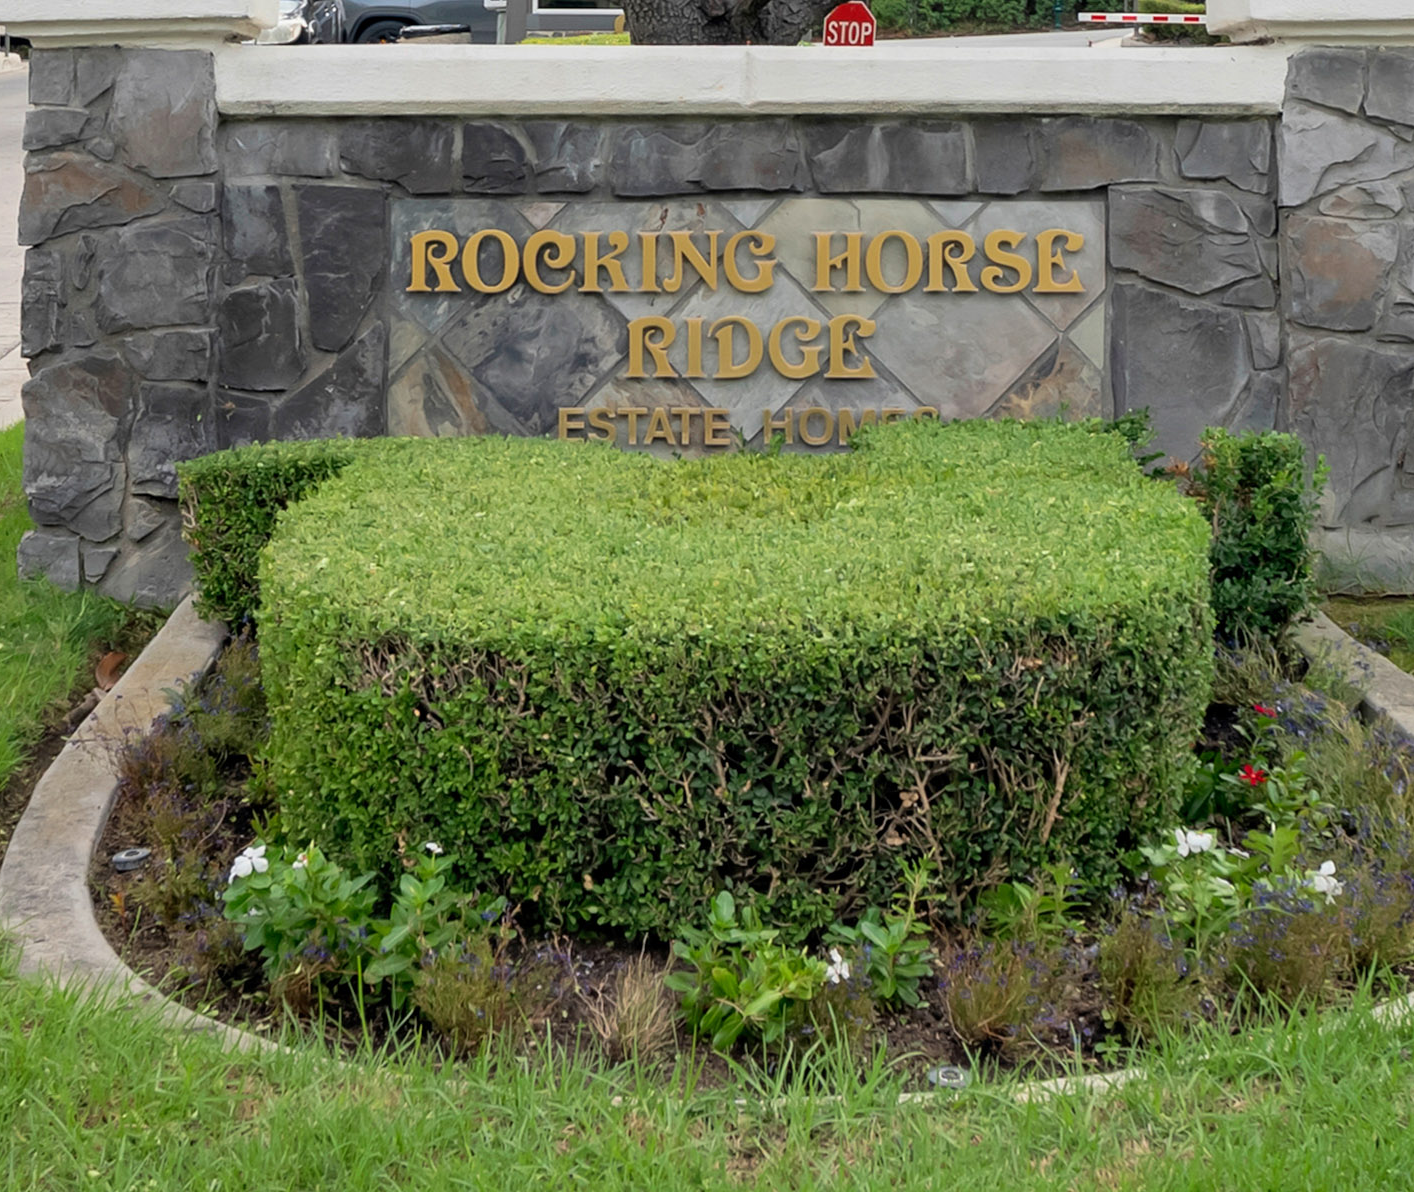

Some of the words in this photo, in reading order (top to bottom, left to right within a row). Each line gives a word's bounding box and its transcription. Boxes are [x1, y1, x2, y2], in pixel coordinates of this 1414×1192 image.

[827, 21, 872, 44] STOP
[406, 229, 778, 294] ROCKING
[810, 229, 1086, 294] HORSE
[623, 314, 878, 379] RIDGE
[558, 407, 731, 446] ESTATE
